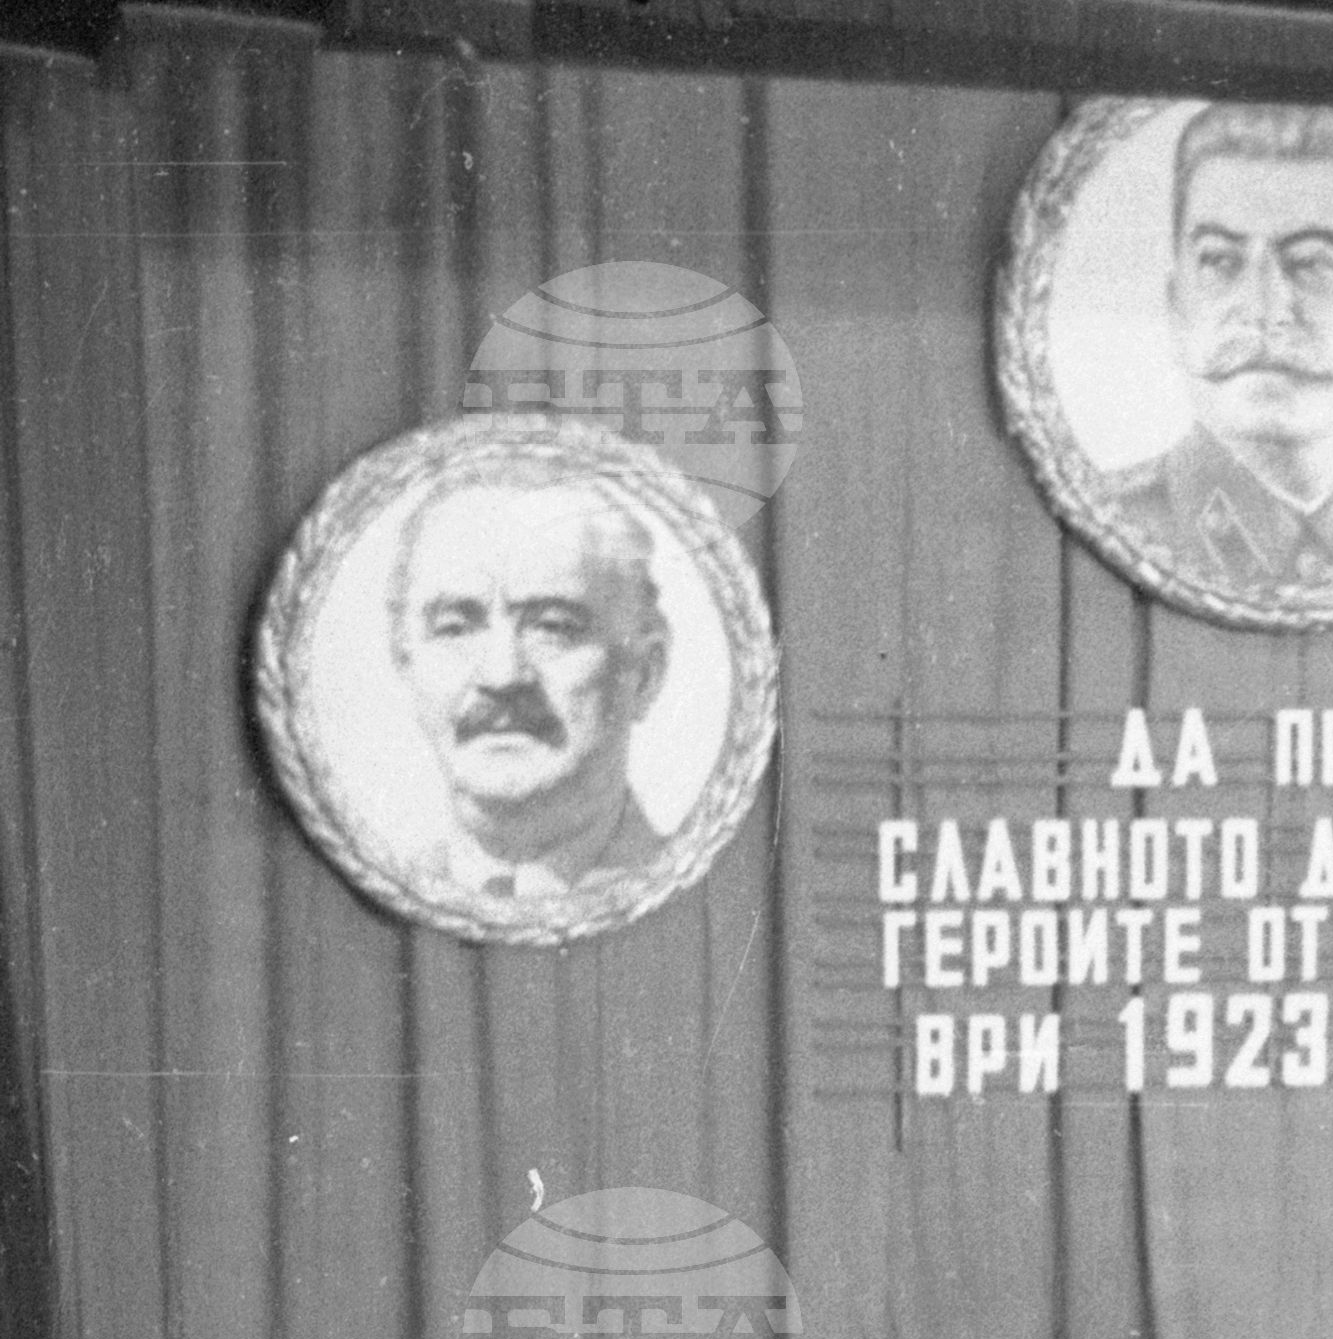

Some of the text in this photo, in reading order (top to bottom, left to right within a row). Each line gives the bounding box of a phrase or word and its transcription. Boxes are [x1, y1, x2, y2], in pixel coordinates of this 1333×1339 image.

[1111, 707, 1218, 787] ДА
[878, 816, 1260, 902] СЛАВНОТО
[883, 906, 1203, 988] ГЕРОИТЕ
[1247, 904, 1330, 982] ОТ
[915, 1012, 1061, 1096] ВРИ
[1117, 991, 1330, 1092] 1923
